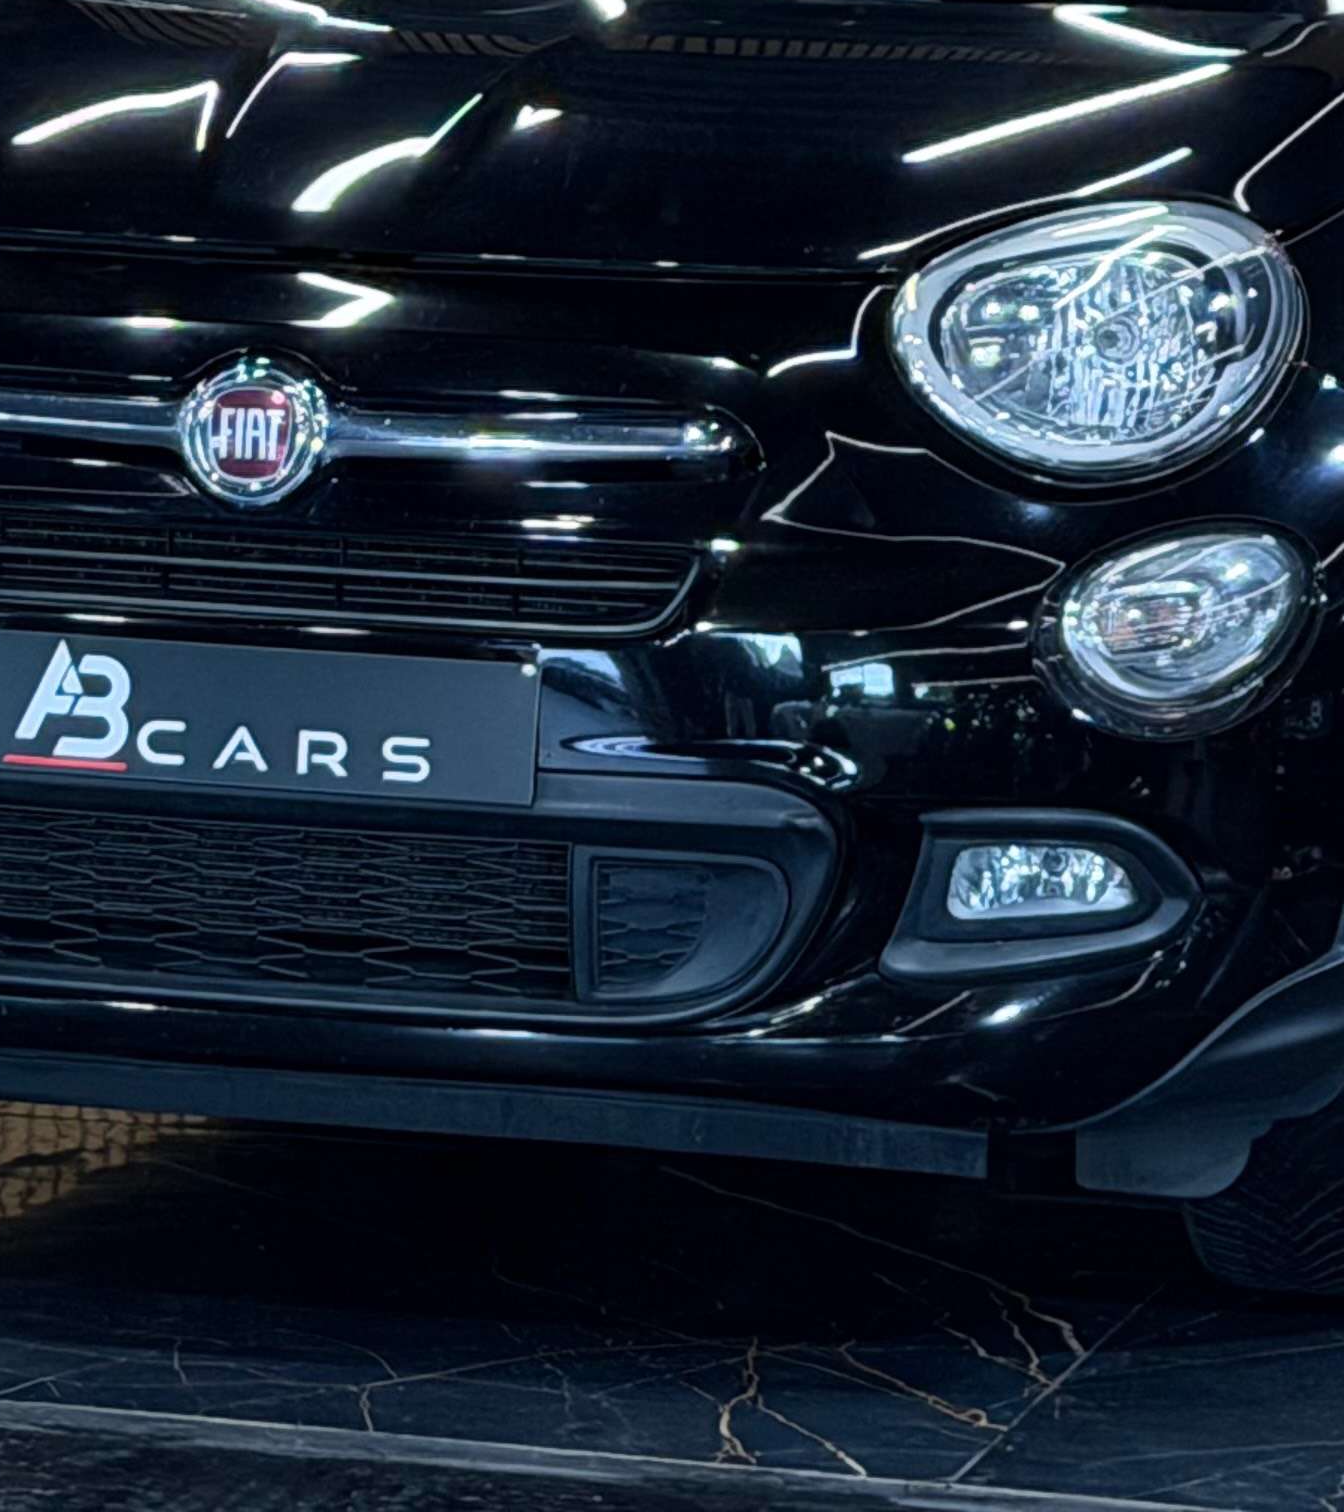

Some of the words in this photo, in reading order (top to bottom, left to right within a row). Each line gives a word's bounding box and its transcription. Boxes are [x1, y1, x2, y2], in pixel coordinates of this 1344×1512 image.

[217, 407, 286, 461] FIAT
[14, 638, 131, 759] AB
[137, 720, 431, 782] CARS
